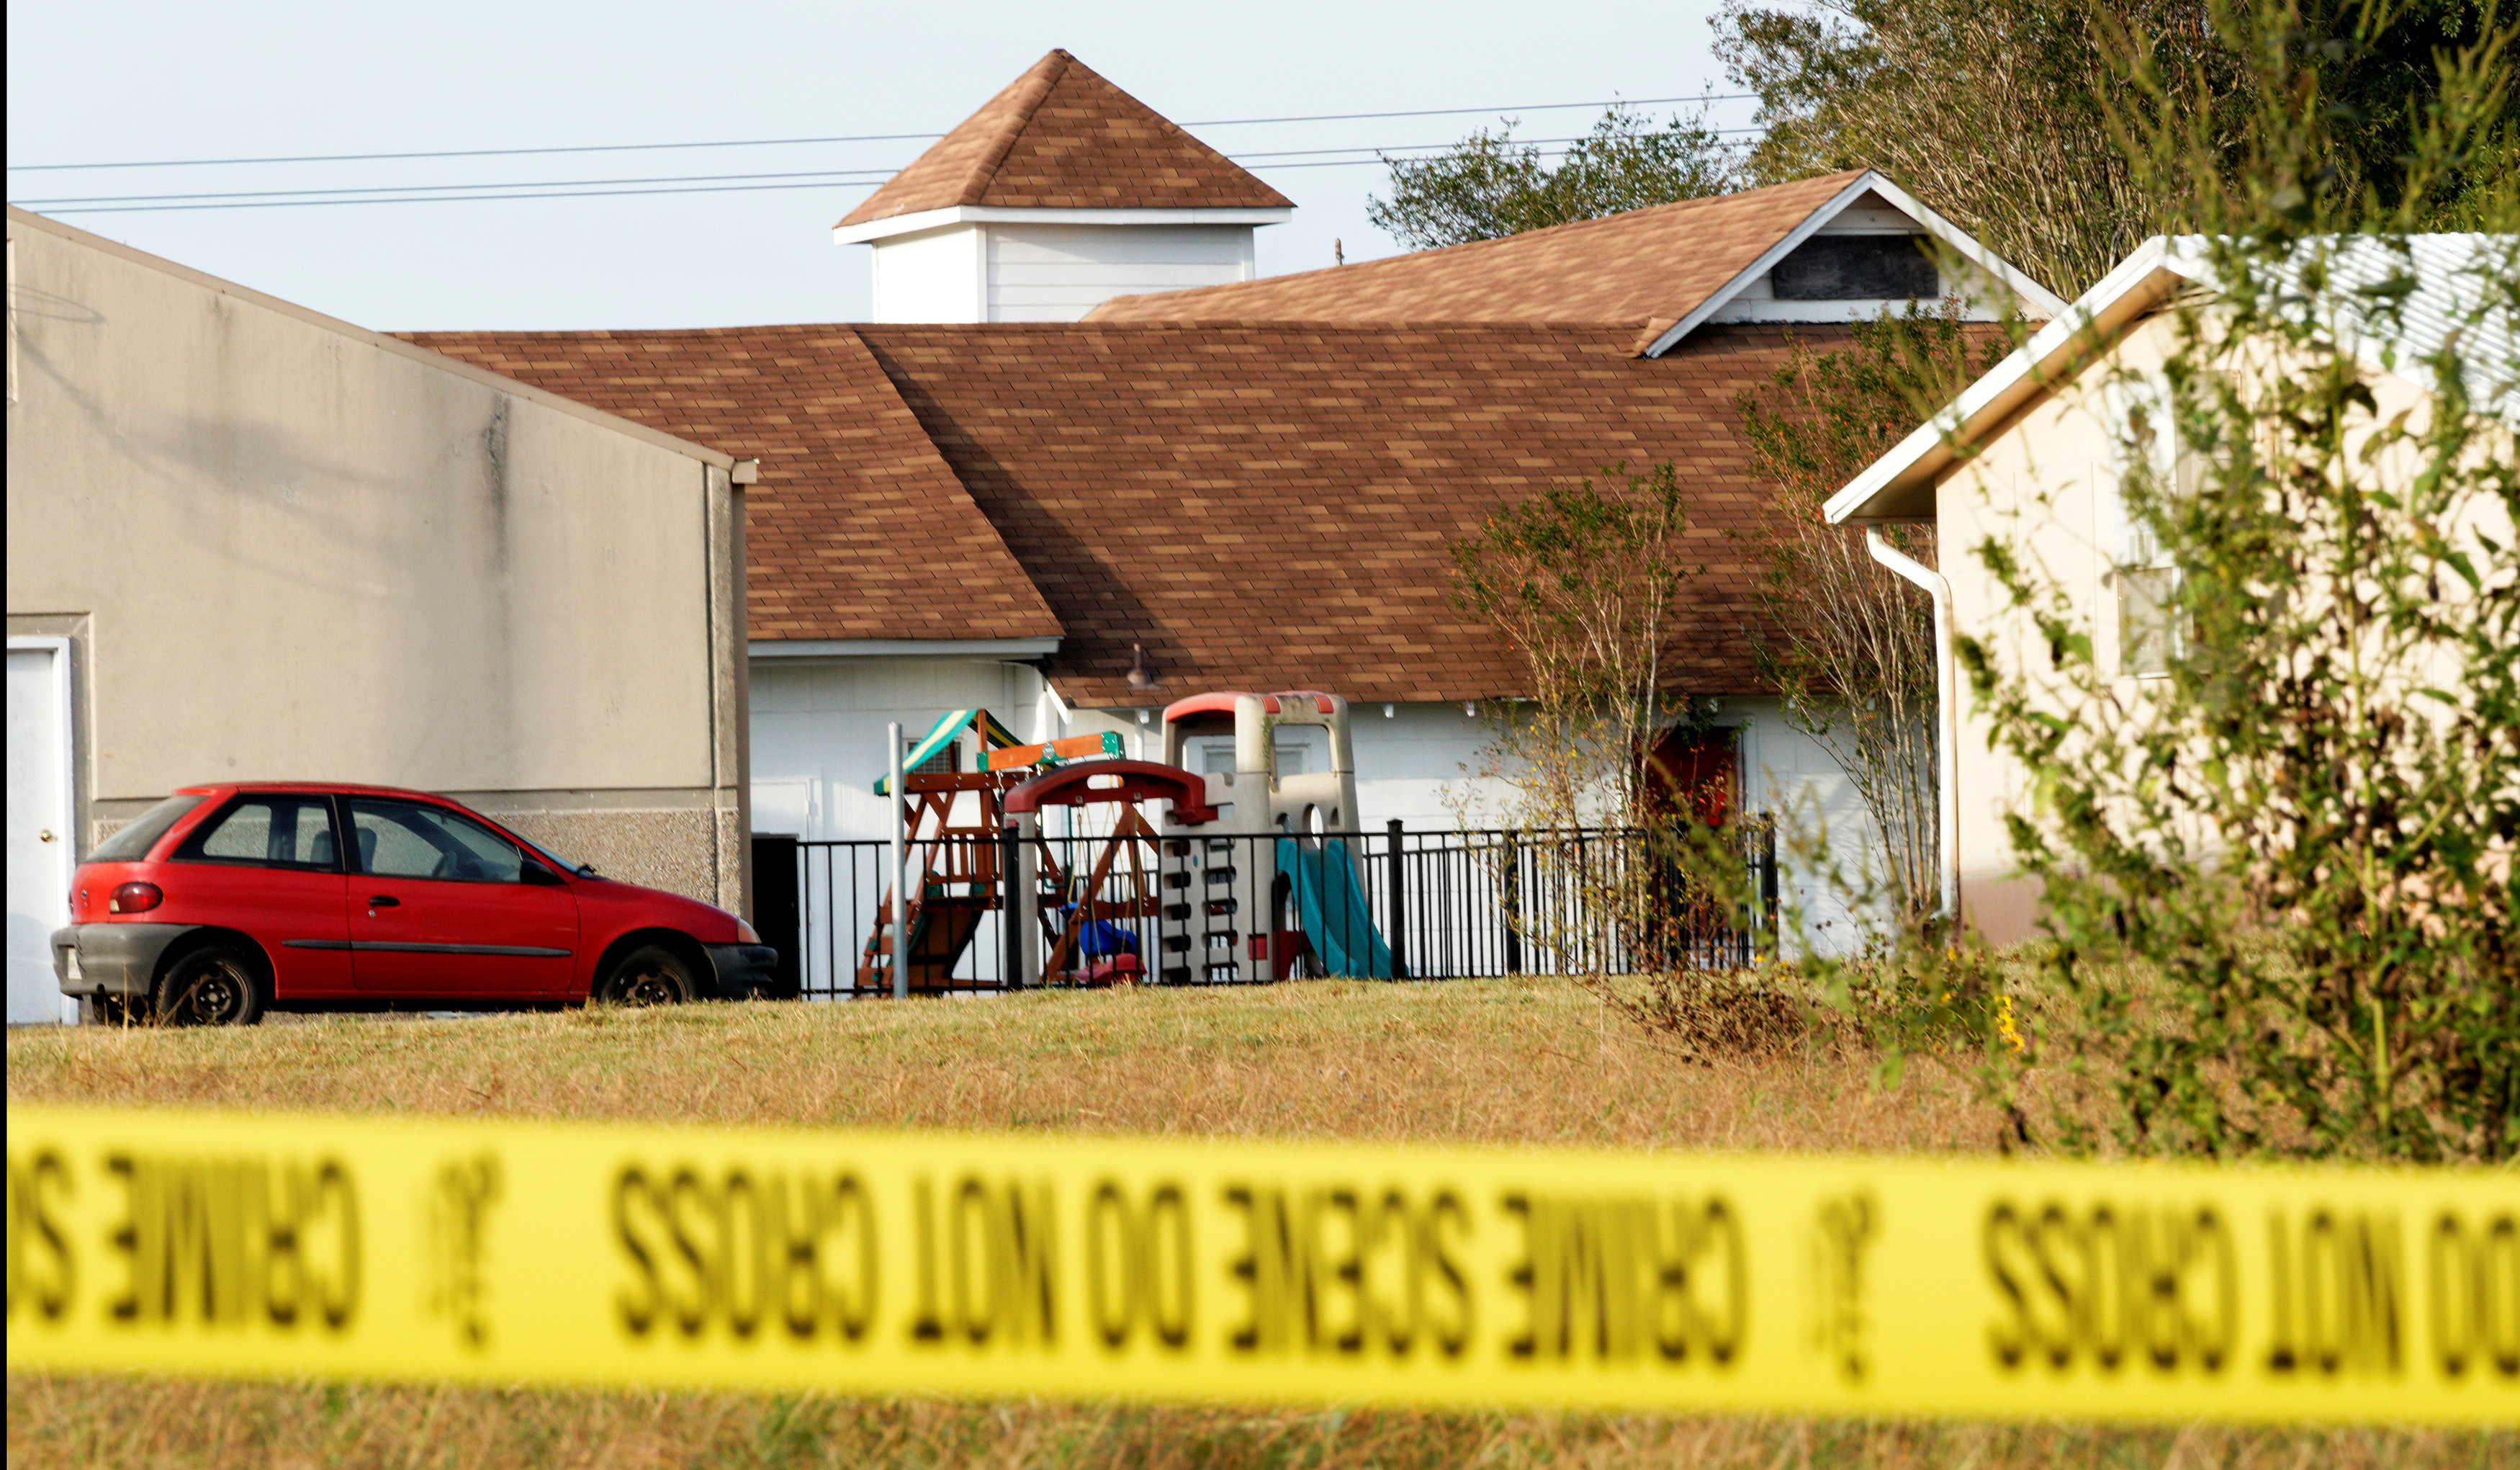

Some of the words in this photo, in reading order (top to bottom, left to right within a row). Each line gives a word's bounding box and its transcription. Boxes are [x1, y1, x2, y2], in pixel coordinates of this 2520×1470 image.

[99, 1149, 361, 1337] CRIME
[611, 1162, 879, 1350] CROSS
[903, 1173, 1061, 1354] NOT
[1086, 1177, 1197, 1358] DO
[1219, 1181, 1476, 1366] SCENE
[1497, 1189, 1747, 1373] CRIME
[1982, 1198, 2238, 1381] CROSS
[2259, 1206, 2408, 1384] NOT
